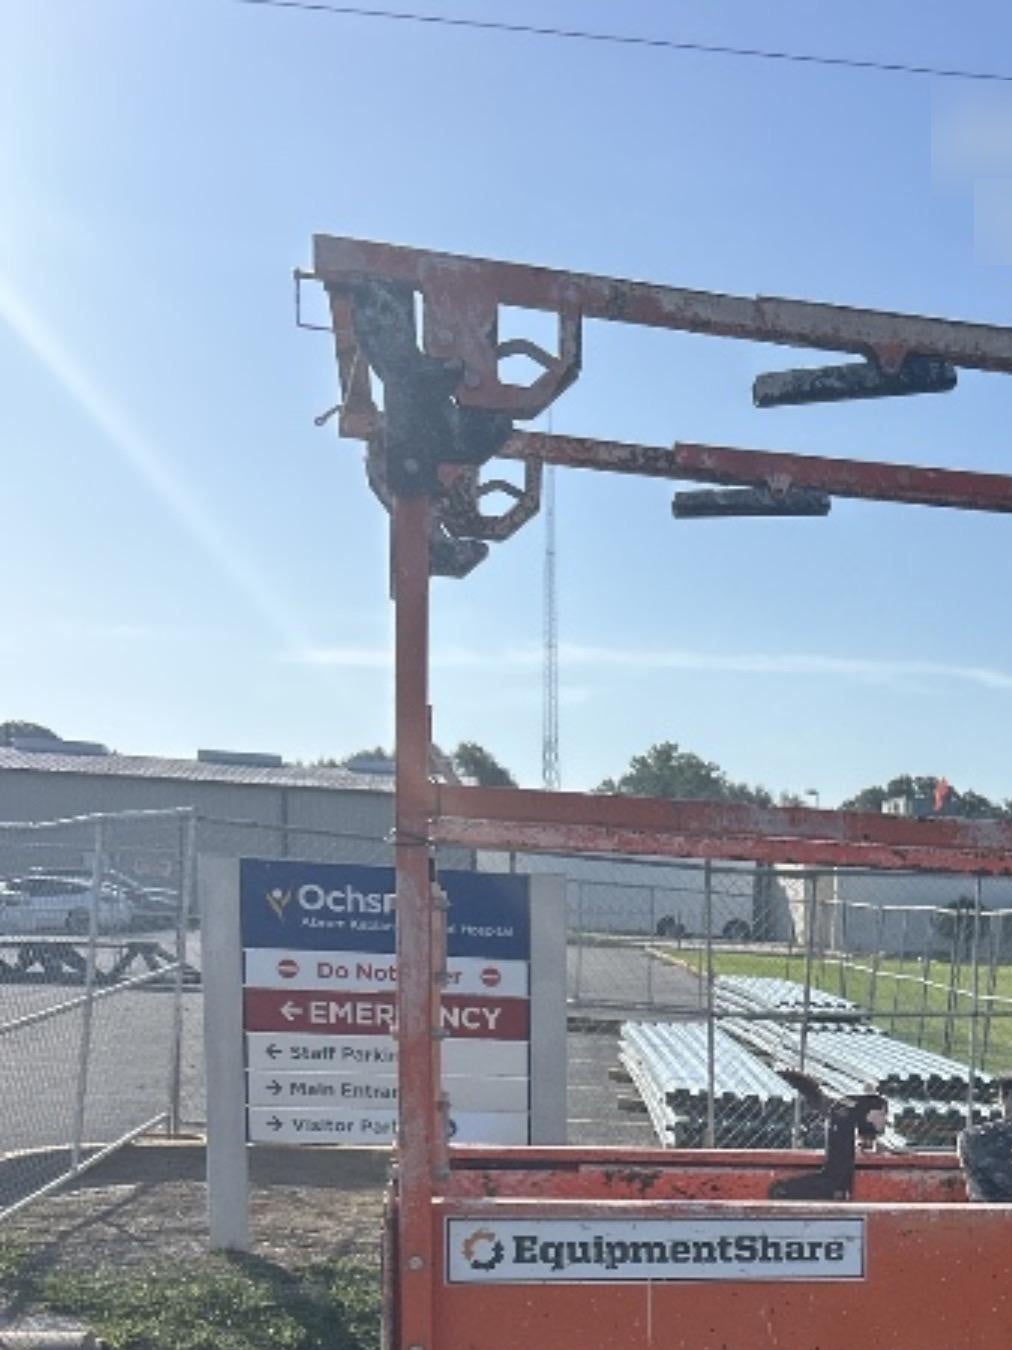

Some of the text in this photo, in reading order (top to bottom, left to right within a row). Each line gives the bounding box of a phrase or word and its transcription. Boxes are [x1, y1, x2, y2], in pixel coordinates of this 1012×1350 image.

[299, 884, 447, 914] Ochsn
[317, 962, 397, 982] Do Not
[310, 1001, 501, 1029] EMERNCY
[289, 1046, 394, 1062] Staff Parki
[290, 1083, 397, 1099] Main Entra
[292, 1119, 353, 1133] Visitor
[512, 1235, 845, 1270] EquipmentShare
